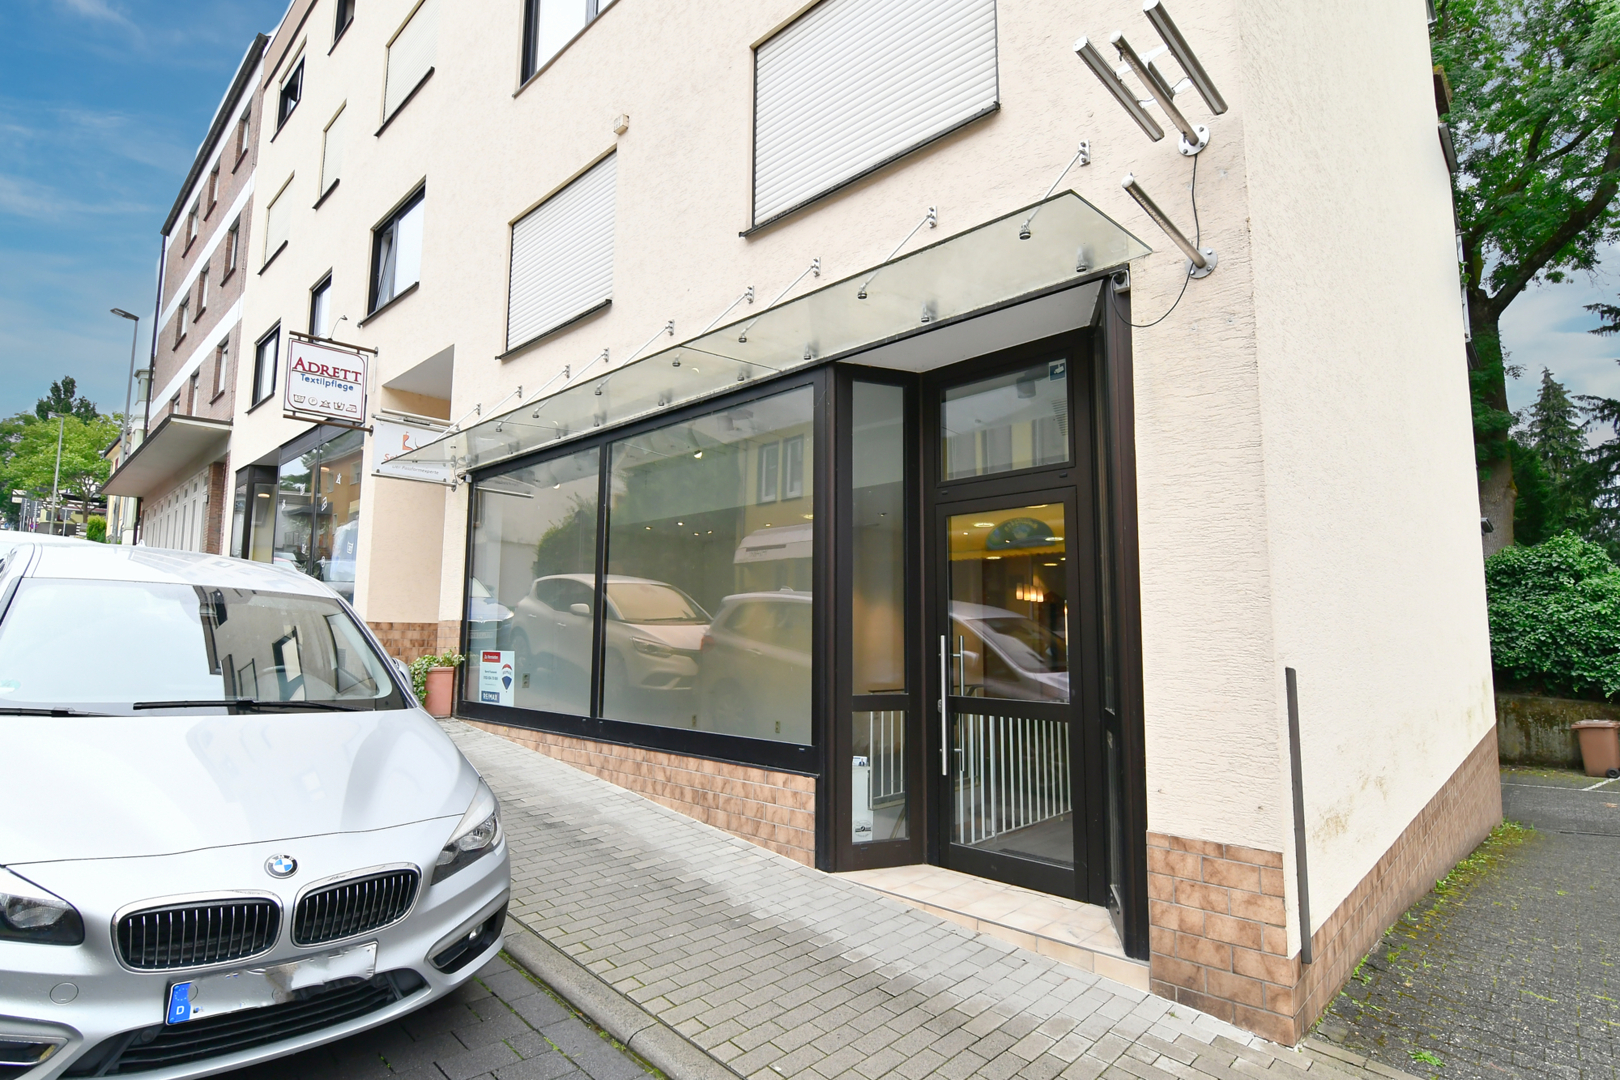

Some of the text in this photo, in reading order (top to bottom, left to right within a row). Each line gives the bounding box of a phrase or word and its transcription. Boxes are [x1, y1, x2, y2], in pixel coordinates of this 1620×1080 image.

[292, 357, 361, 382] ADRETT
[301, 373, 354, 391] Textilpflege
[176, 1005, 185, 1015] D
